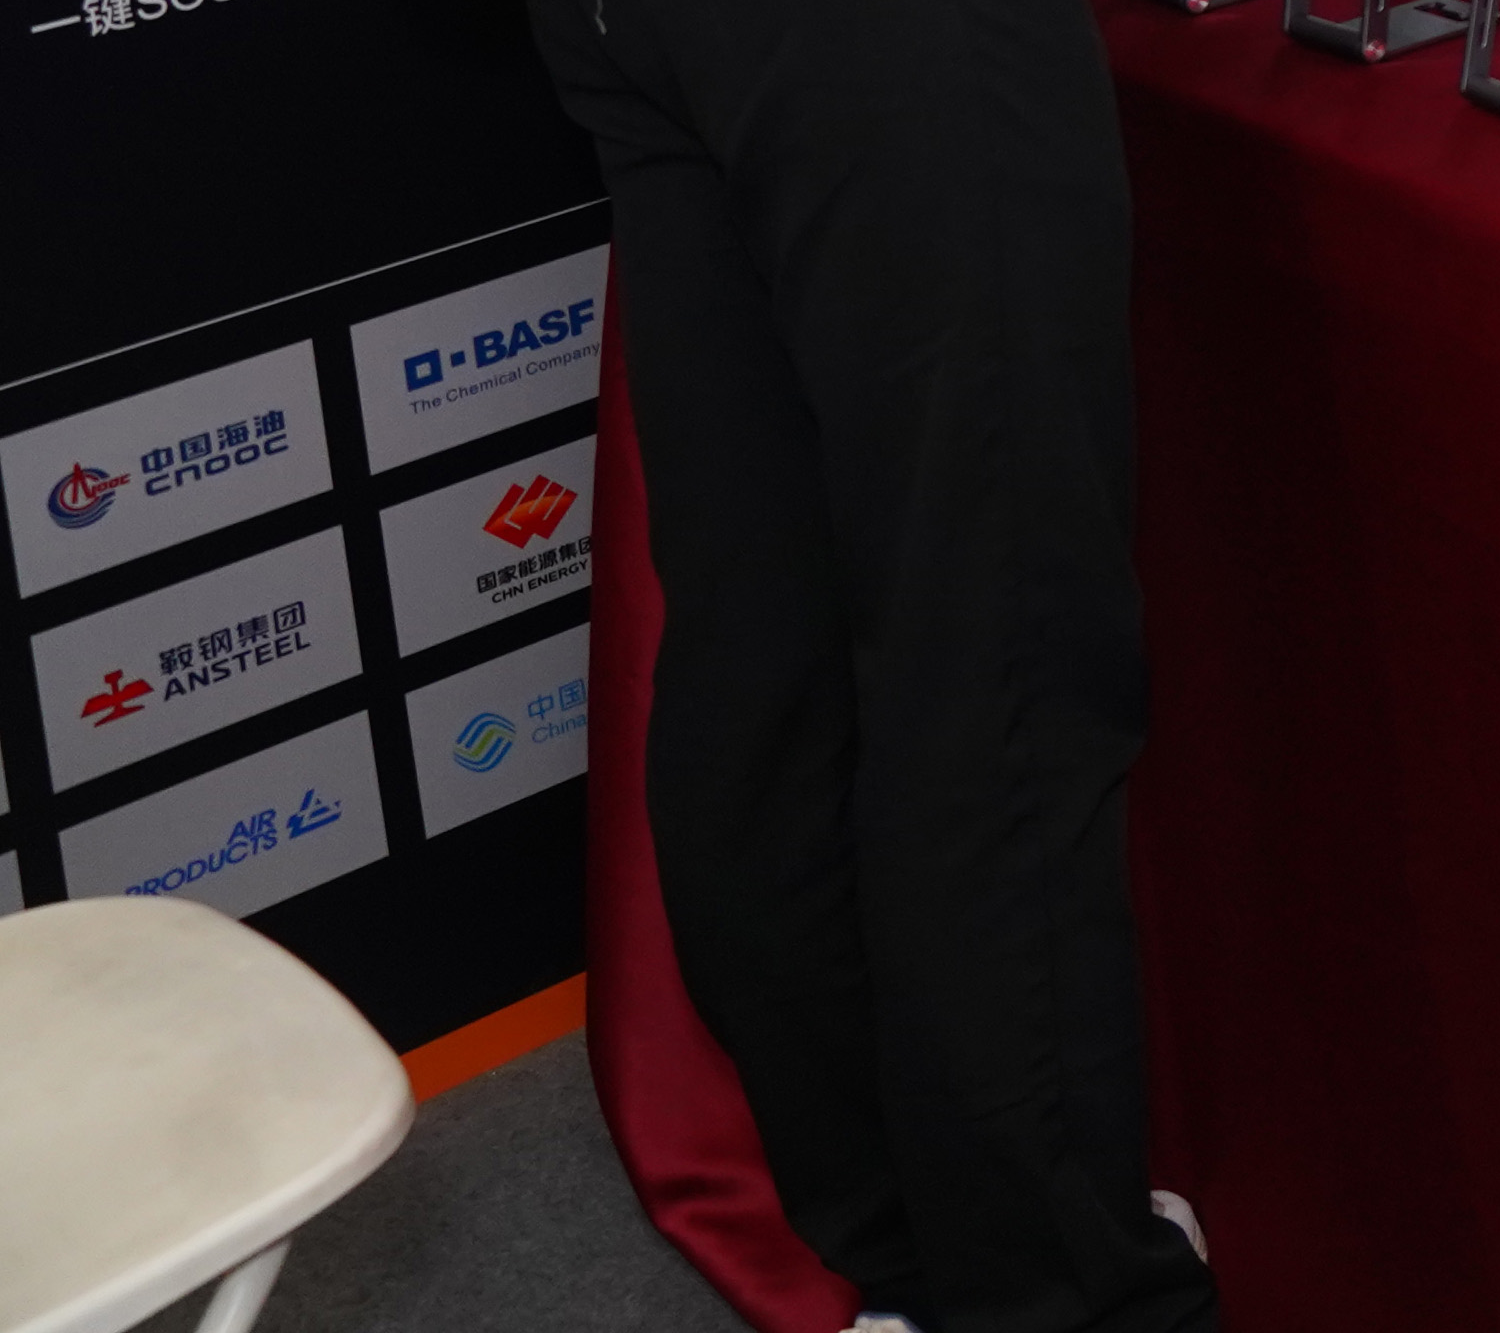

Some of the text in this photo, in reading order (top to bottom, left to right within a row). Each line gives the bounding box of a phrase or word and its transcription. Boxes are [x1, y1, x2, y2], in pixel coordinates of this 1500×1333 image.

[473, 297, 595, 370] BASF
[409, 339, 600, 416] The Chemical Company
[140, 409, 287, 476] 中国海油
[491, 558, 590, 605] CHN ENERGY
[159, 601, 306, 675] 鞍钢集团
[162, 632, 312, 703] ANSTEEL
[527, 678, 587, 723] 中国
[530, 712, 589, 745] China
[227, 807, 278, 845] AIR
